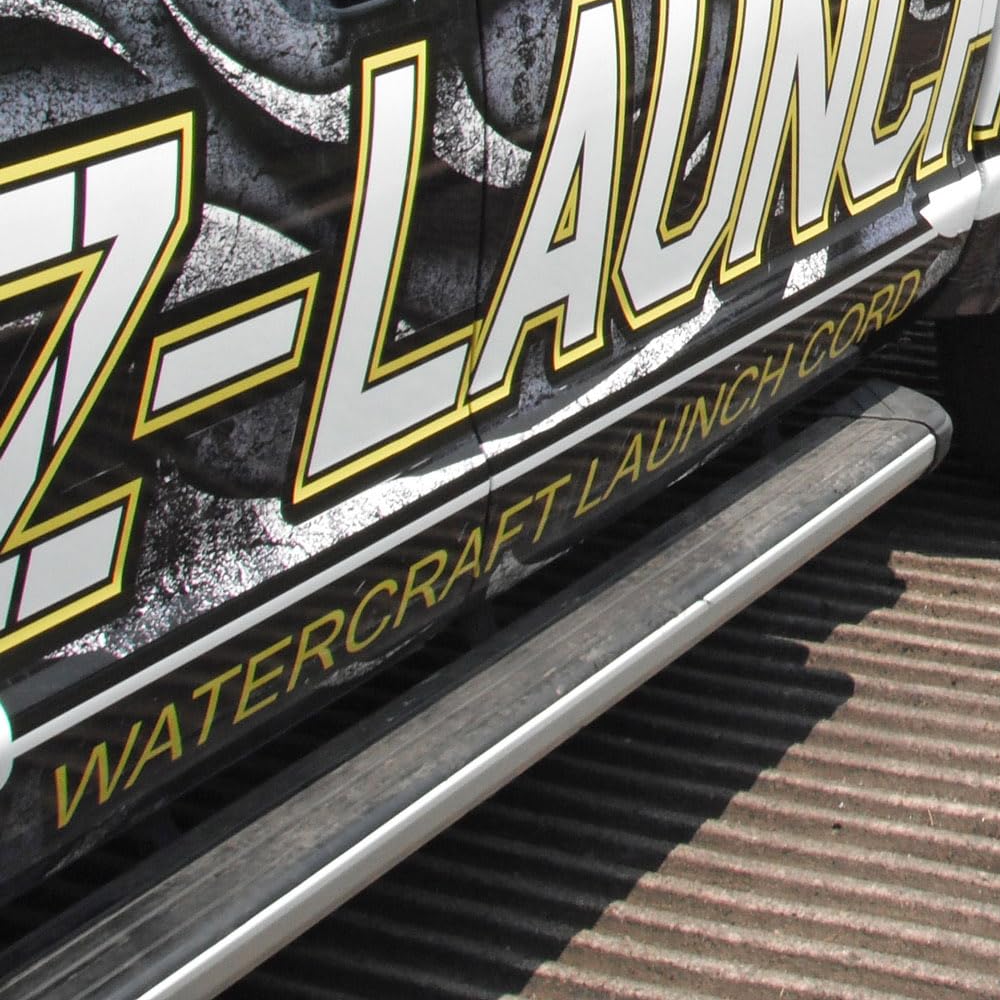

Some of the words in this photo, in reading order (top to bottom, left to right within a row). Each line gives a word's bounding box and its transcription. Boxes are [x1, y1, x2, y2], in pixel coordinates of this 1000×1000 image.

[55, 473, 573, 830] WATERCRAFT
[573, 343, 794, 518] LAUNCH
[799, 269, 921, 377] CORD
